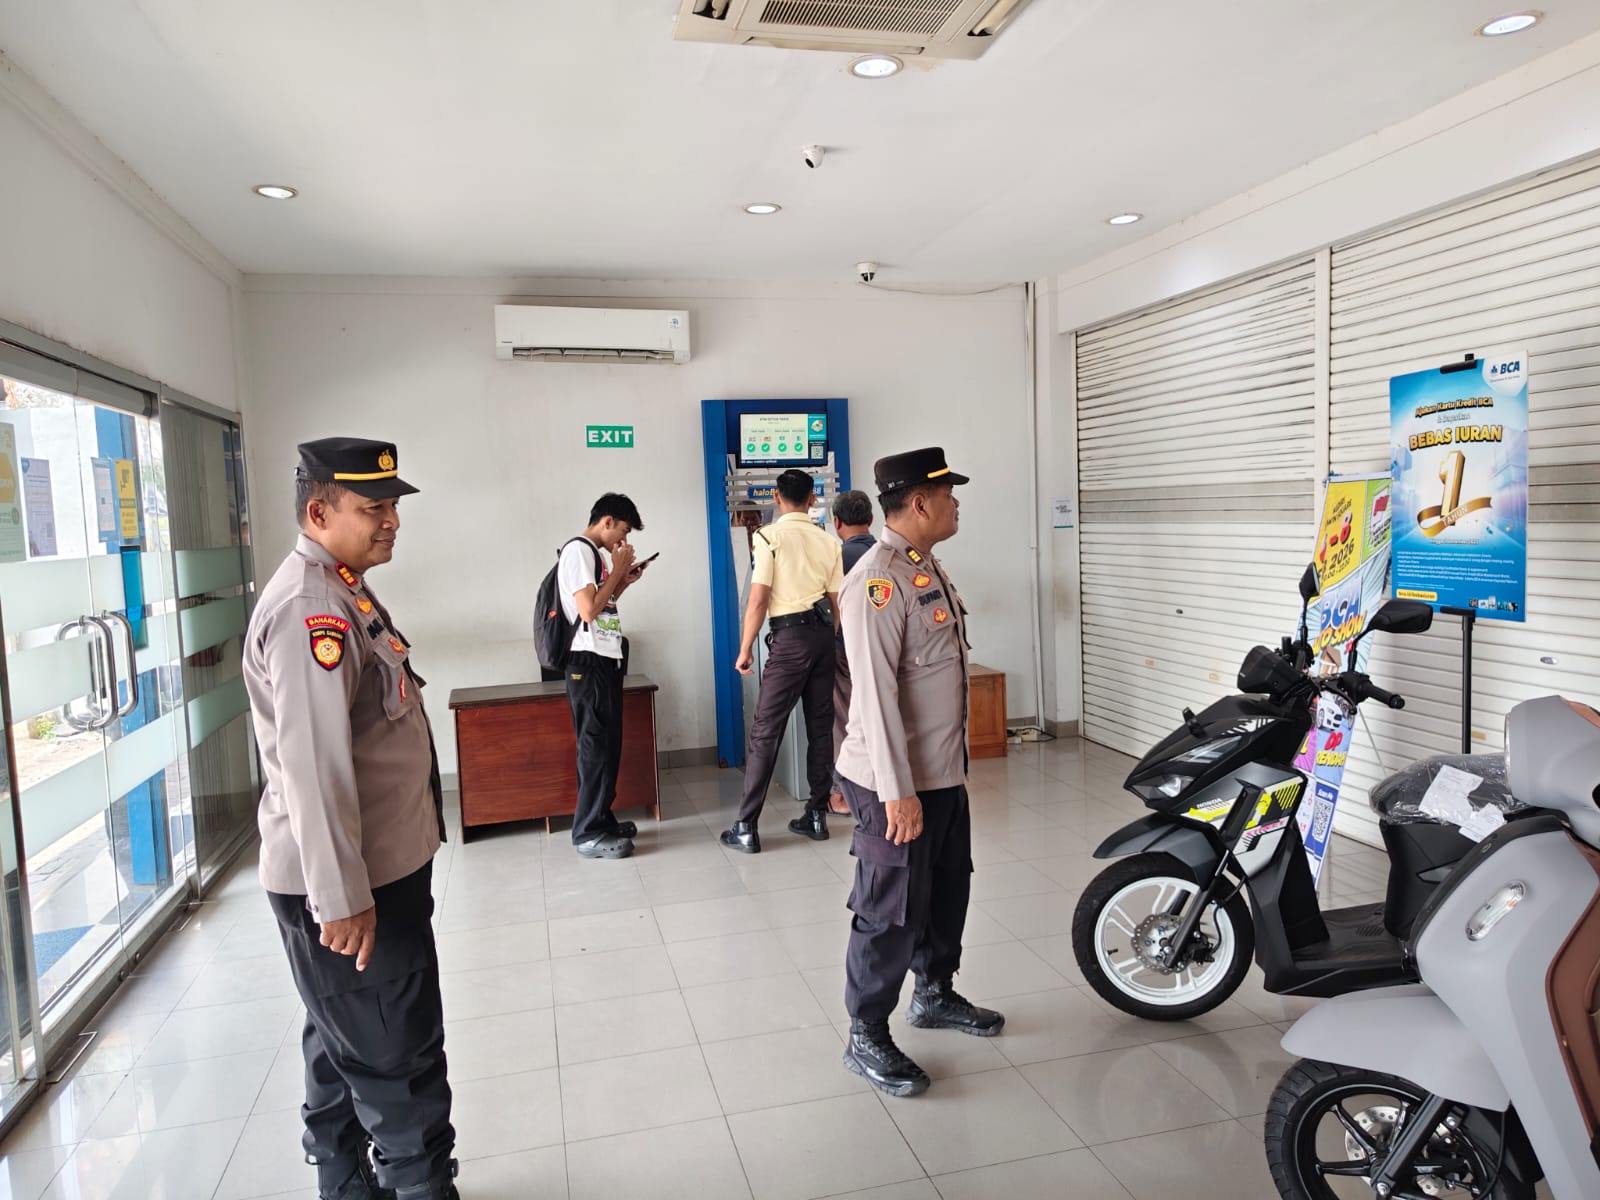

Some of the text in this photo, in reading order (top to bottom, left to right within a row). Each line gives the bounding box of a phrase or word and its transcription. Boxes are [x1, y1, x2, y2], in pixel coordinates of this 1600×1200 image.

[1500, 361, 1520, 374] BCA
[1437, 401, 1456, 412] Kartu
[1456, 397, 1478, 409] Kredit
[1478, 396, 1494, 407] BCA
[588, 430, 632, 443] EXIT
[1409, 425, 1503, 450] BEBAS IURAN
[1329, 538, 1355, 570] 2026
[1331, 609, 1368, 646] SHOW
[1324, 731, 1343, 751] DP
[1196, 798, 1223, 809] HONDA
